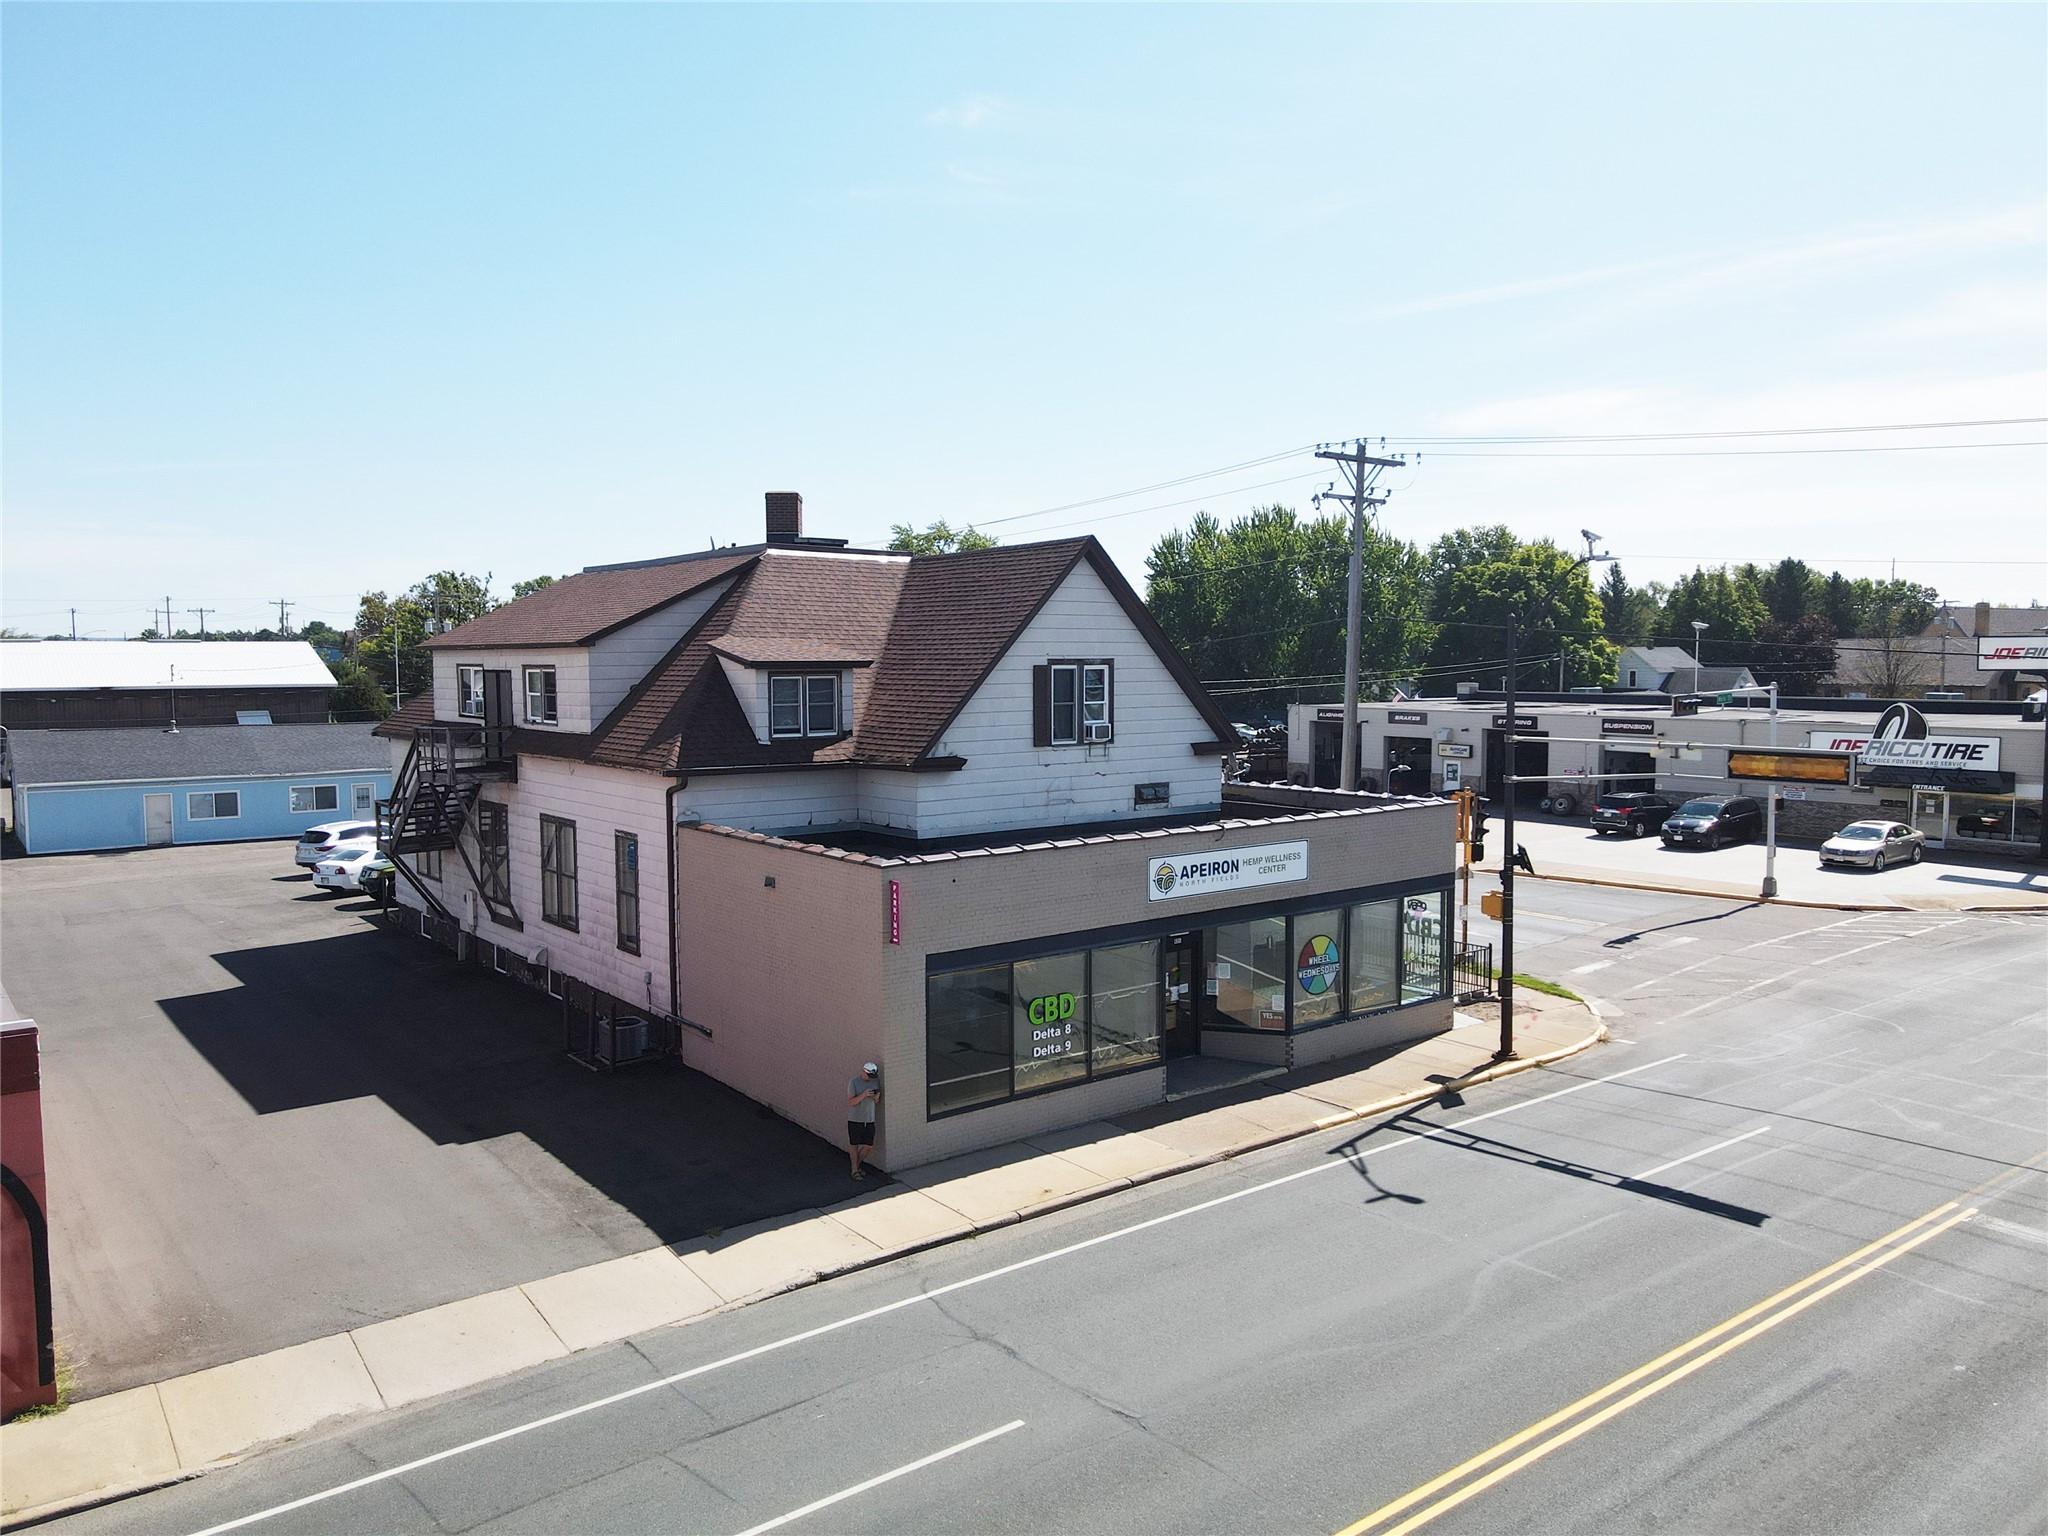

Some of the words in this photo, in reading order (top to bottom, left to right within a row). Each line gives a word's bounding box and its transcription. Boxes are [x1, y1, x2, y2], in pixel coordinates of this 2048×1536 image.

[1497, 718, 1532, 726] STRING
[1603, 722, 1653, 731] SUSPENSION
[1911, 783, 1946, 791] ENTRANCE
[1180, 858, 1240, 880] APEIRON
[1242, 856, 1263, 867] HEMP
[1264, 852, 1301, 864] WELLNESS
[1258, 863, 1286, 875] CENTER
[1179, 879, 1207, 887] NORTH
[1211, 874, 1240, 884] FIELDS
[1308, 954, 1330, 965] WHEEL
[1298, 963, 1341, 979] WEDNESDAYS
[1028, 993, 1076, 1025] CBD
[1033, 1027, 1061, 1041] Delta
[1064, 1023, 1072, 1035] 8
[1033, 1044, 1061, 1058] Delta
[1064, 1040, 1072, 1051] 9
